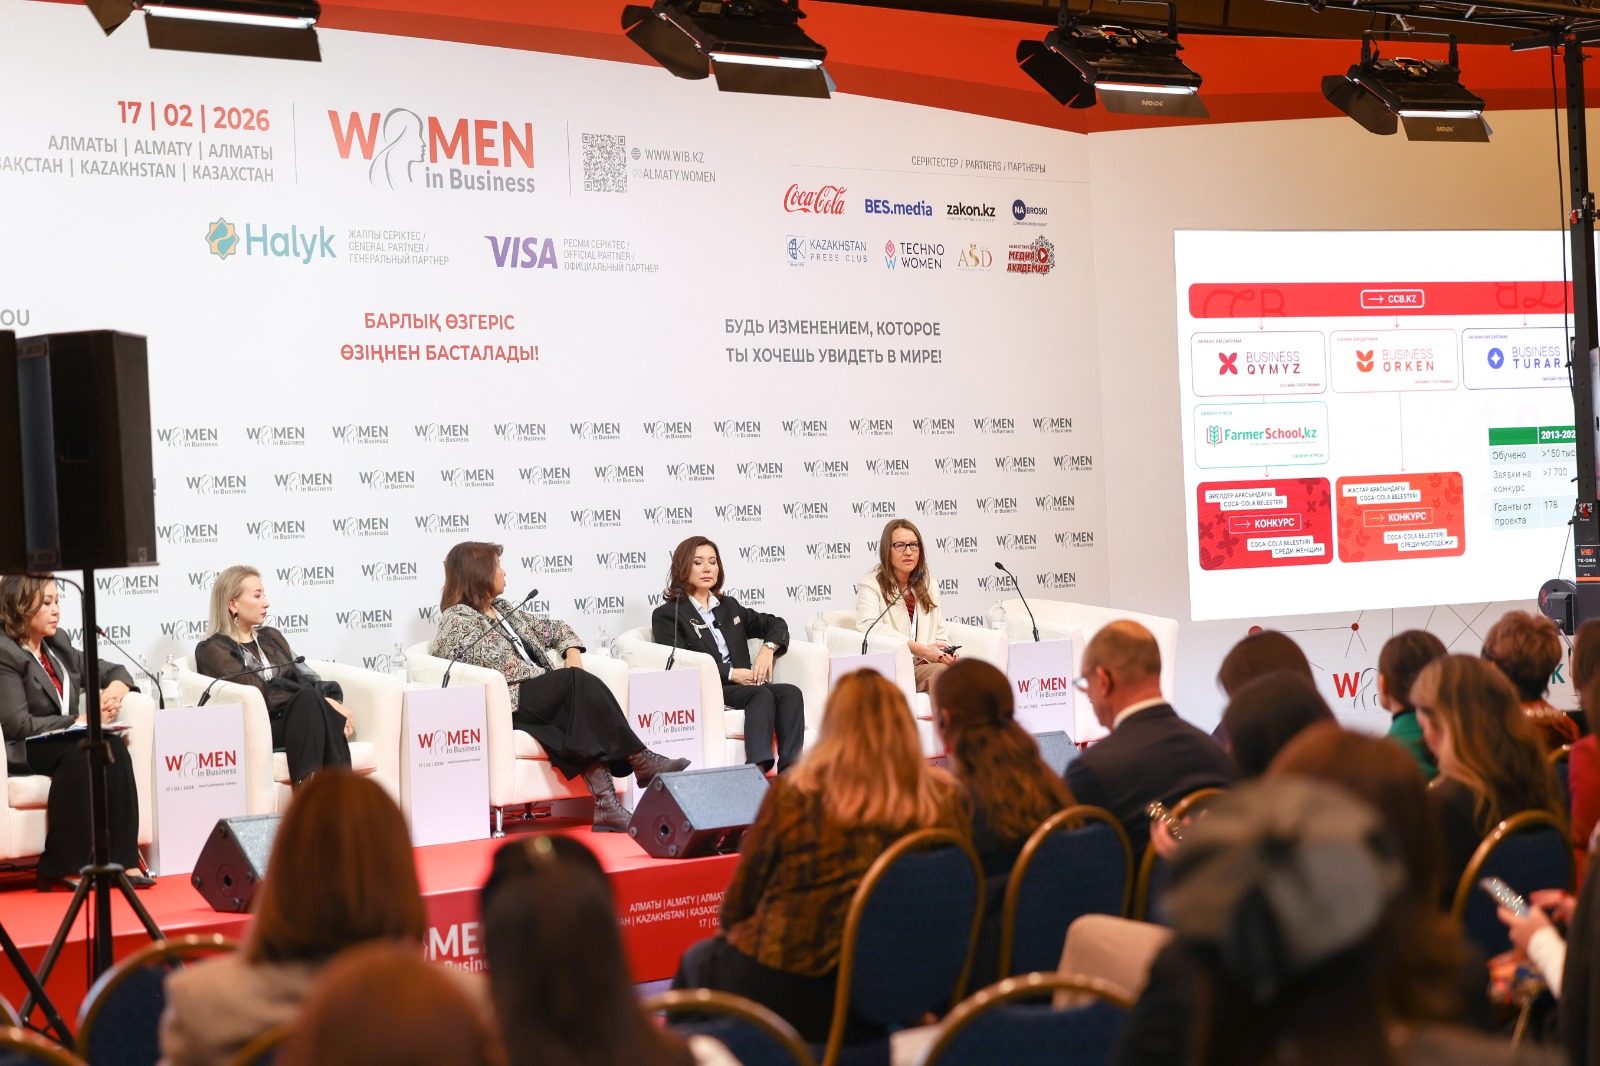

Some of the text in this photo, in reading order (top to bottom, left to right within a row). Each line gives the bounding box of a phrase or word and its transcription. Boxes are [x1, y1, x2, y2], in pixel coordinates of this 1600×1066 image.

[117, 100, 270, 131] 17 02 2026
[48, 135, 273, 160] АЛМАТЫ ALMATY АЛМАТЫ
[645, 149, 704, 163] WWW.WIB.KZ
[80, 159, 176, 178] KAZAKHSTAN
[192, 164, 274, 182] КАЗАХСТАН
[966, 159, 1002, 171] PARTNERS
[1008, 162, 1046, 174] ПАРТНЕРЫ
[425, 166, 535, 193] in Business
[643, 168, 715, 182] ALMATY.WOMEN
[864, 198, 933, 218] BES.media
[946, 202, 996, 217] zakon.kz
[1026, 206, 1048, 216] BROSKI
[245, 223, 337, 264] Halyk
[348, 241, 424, 253] GENERAL PARTNER
[563, 239, 589, 248] РЕСМИ
[809, 238, 867, 252] KAZAKHSTAN
[899, 242, 945, 256] TECHNO
[484, 235, 558, 270] VISA
[563, 250, 631, 261] OFFICIAL PARTNER
[810, 253, 868, 263] PRESS CLUB
[349, 253, 449, 265] ГЕНЕРАЛЬНЫЙ ПАРТНЕР
[901, 257, 942, 269] WOMEN
[564, 261, 659, 273] ОФИЦИАЛЬНЫЙ ПАРТНЕР
[1007, 263, 1050, 273] АКАДЕМИЯ
[364, 312, 515, 333] БАРЛЫҚ ӨЗГЕРІС
[725, 318, 941, 338] БУДЬ ИЗМЕНЕНИЕМ, КОТОРОЕ
[425, 344, 539, 364] БАСТАЛАДЫ!
[726, 348, 942, 365] ТЫ ХОЧЕШЬ УВИДЕТЬ В МИРЕ!
[1246, 351, 1300, 363] BUSINESS
[1382, 348, 1434, 360] BUSINESS
[1511, 346, 1561, 358] BUSINESS
[1247, 363, 1301, 375] QYMYZ
[1512, 358, 1561, 369] TURAR
[1541, 430, 1576, 440] 2013-202
[1492, 451, 1527, 462] Обучено
[1493, 470, 1532, 479] Заявки на
[308, 484, 332, 492] Business
[1346, 486, 1369, 494] ЖАСТАР
[1493, 485, 1525, 494] конкурс
[1223, 500, 1256, 508] COCA-COLA
[1359, 494, 1391, 502] COCA-COLA
[1494, 502, 1532, 512] Гранты от
[1544, 500, 1558, 509] 178
[1388, 511, 1427, 522] КОНКУРС
[1495, 517, 1527, 527] проекта
[1254, 517, 1295, 529] КОНКУРС
[1387, 533, 1418, 541] COCA-COLA
[1420, 539, 1454, 547] МОЛОДЕЖИ
[1250, 540, 1283, 548] COCA-COLA
[1295, 546, 1322, 554] ЖЕНЩИН
[671, 725, 695, 733] Business
[454, 745, 481, 753] Business
[197, 768, 237, 777] in Business
[630, 892, 726, 912] АЛМАТЫ ALMATY АЛМАТ
[636, 911, 685, 924] KAZAKHSTAN
[690, 904, 719, 917] КАЗАХС
[699, 919, 706, 928] 17
